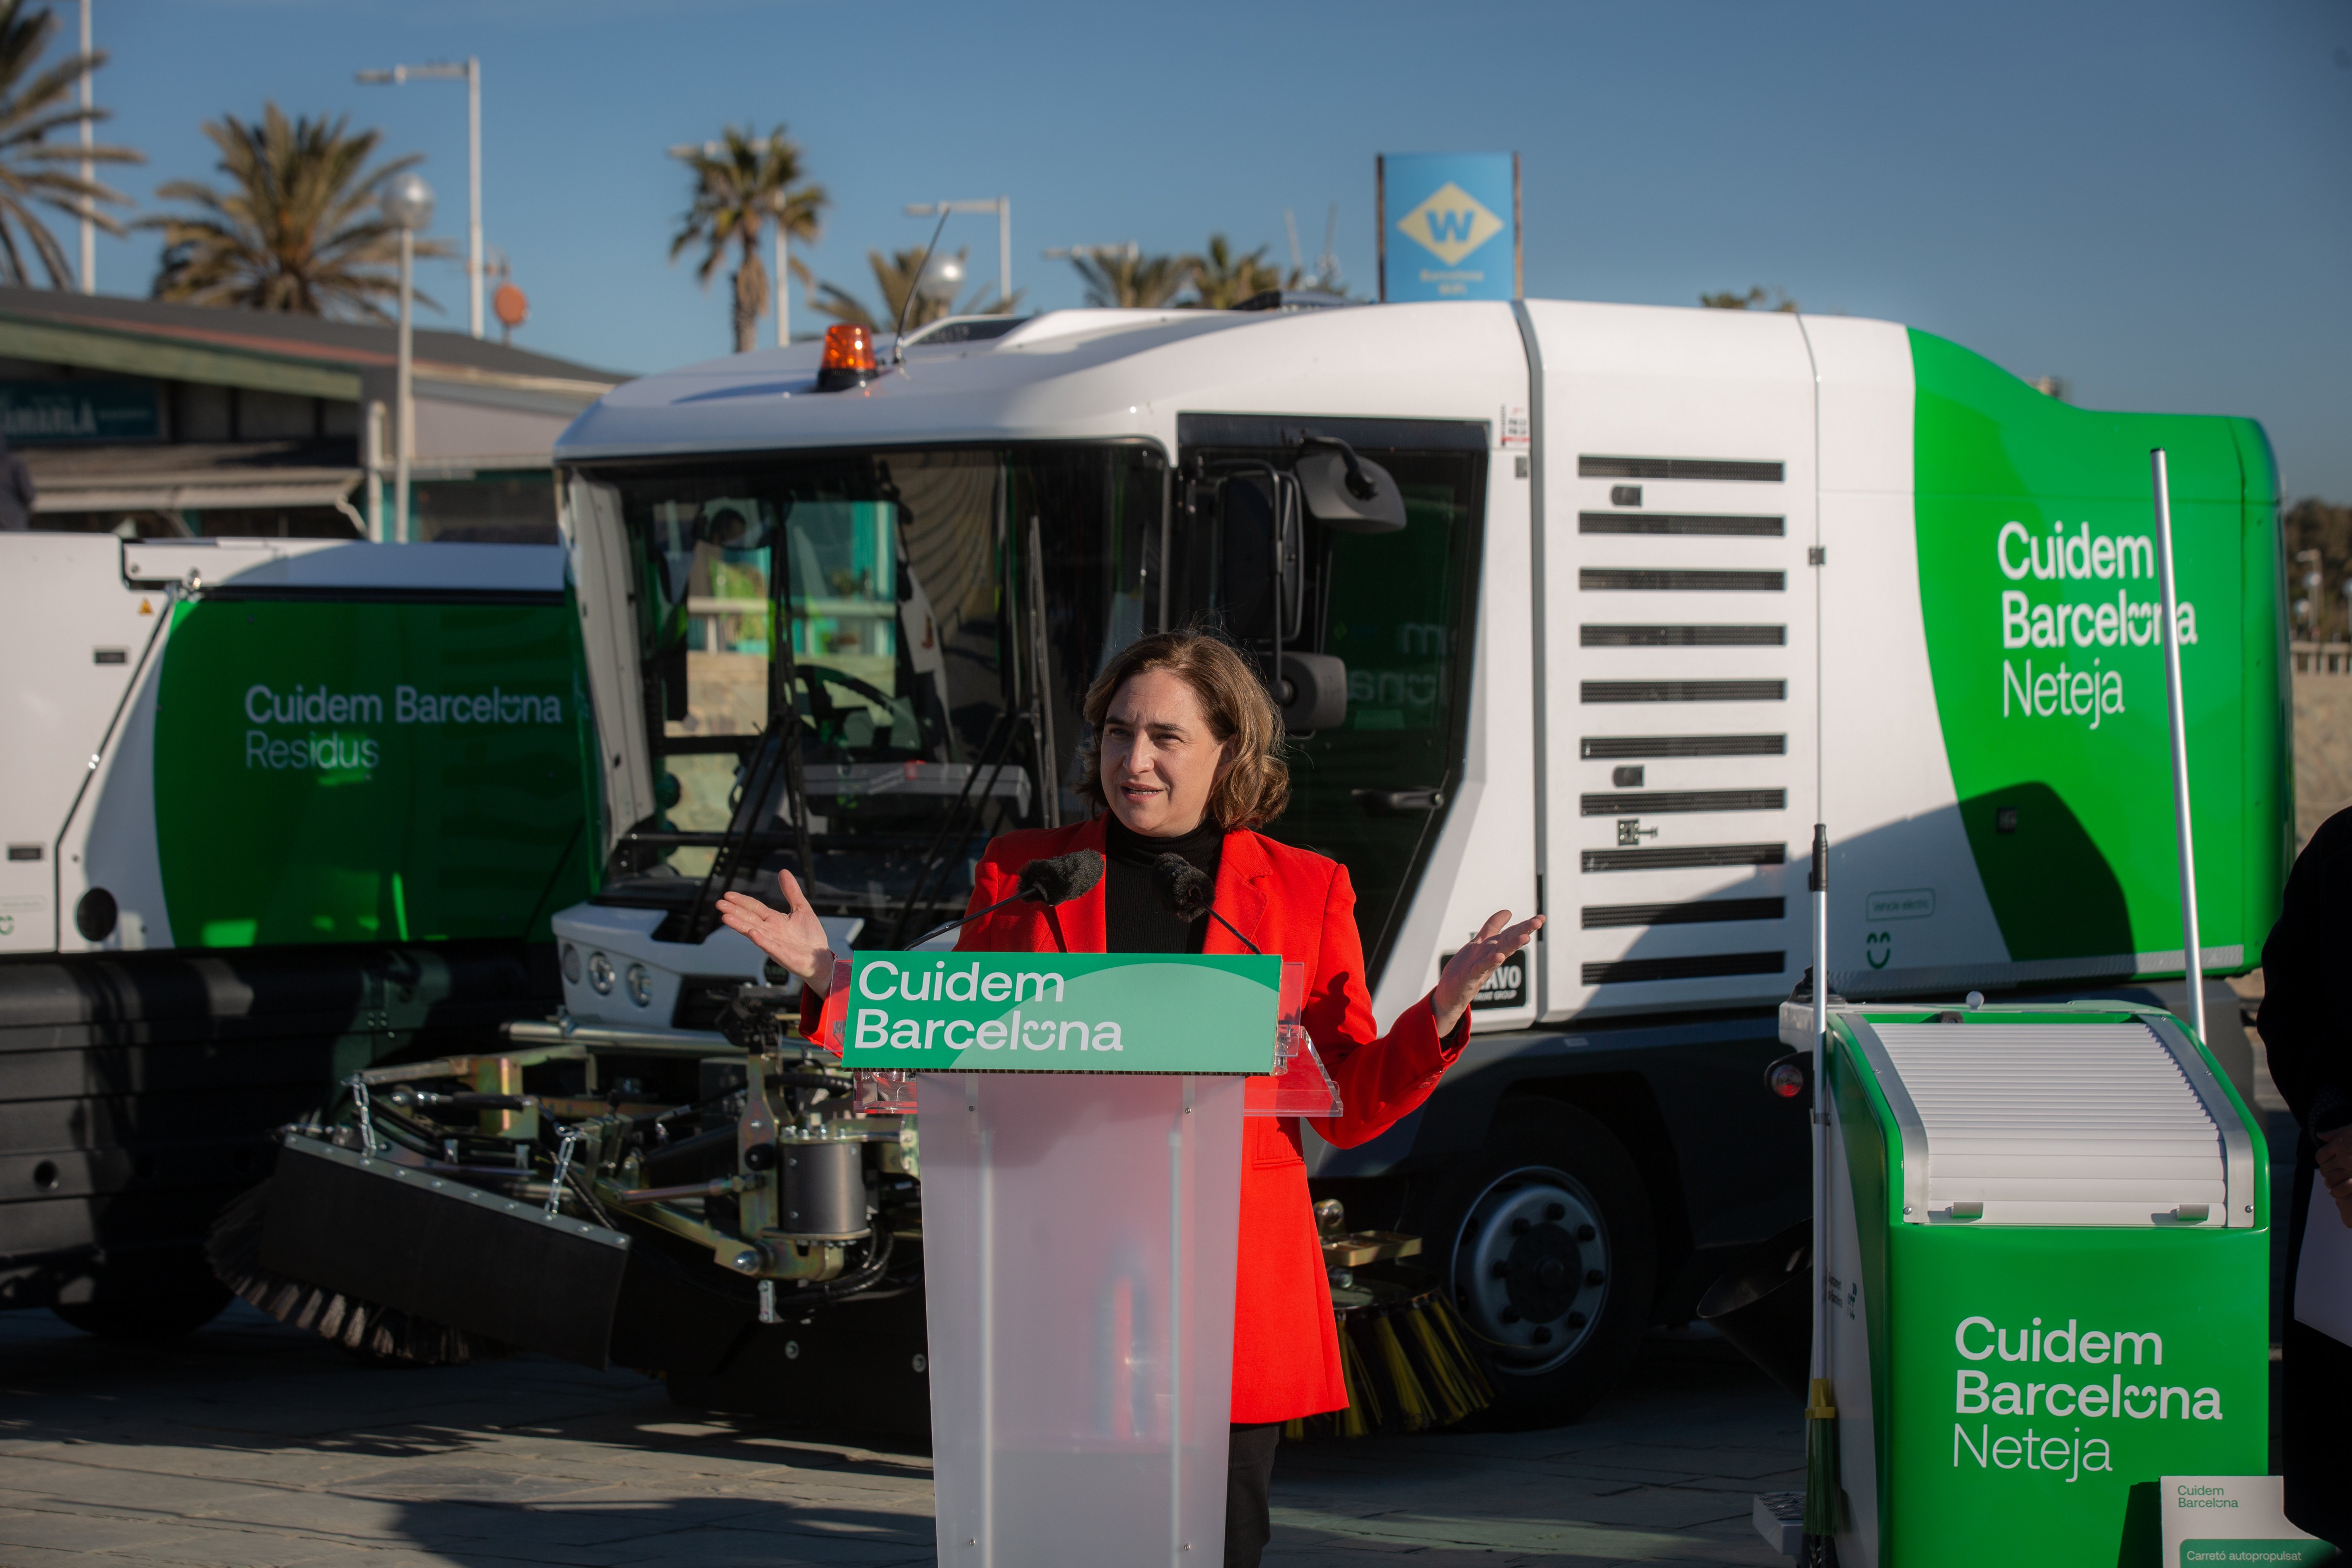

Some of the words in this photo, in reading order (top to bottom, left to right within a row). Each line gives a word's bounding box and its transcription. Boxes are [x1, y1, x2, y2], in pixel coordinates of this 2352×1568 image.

[1426, 210, 1475, 243] W
[1998, 520, 2154, 580] Cuidem
[245, 685, 382, 723] Cuidem
[396, 686, 561, 723] Barcelona
[2004, 658, 2125, 730] Neteja
[246, 730, 379, 769] Residus
[859, 961, 1064, 1001] Cuidem
[1481, 965, 1522, 990] AVO
[855, 1008, 1123, 1051] Barcelona
[1956, 1317, 2163, 1365] Cuidem
[1956, 1370, 2223, 1420] Barcelona
[1954, 1423, 2113, 1483] Neteja
[2178, 1485, 2224, 1496] Cuidem
[2178, 1497, 2239, 1508] Barcelona
[2186, 1551, 2226, 1561] Carretó
[2229, 1551, 2302, 1563] autopropulsat
